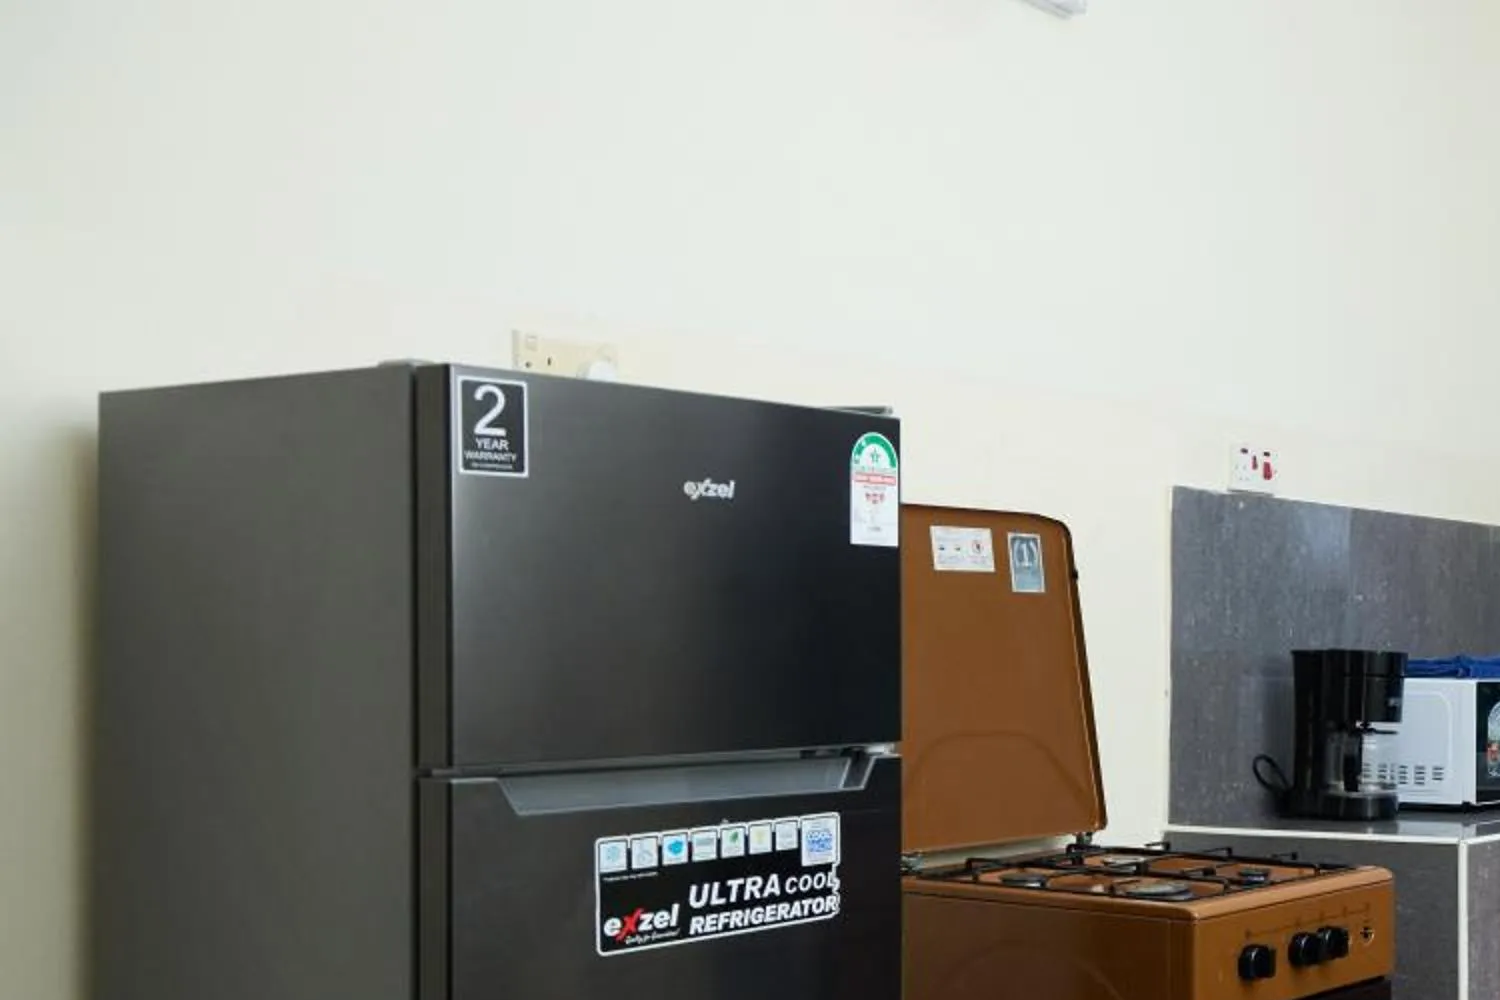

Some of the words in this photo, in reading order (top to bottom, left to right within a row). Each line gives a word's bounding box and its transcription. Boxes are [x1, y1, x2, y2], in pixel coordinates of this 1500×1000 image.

[474, 384, 507, 436] 2
[475, 437, 510, 450] YEAR
[689, 873, 781, 909] ULTRA
[785, 871, 836, 894] COOL
[689, 895, 838, 935] REFRIGERATOR
